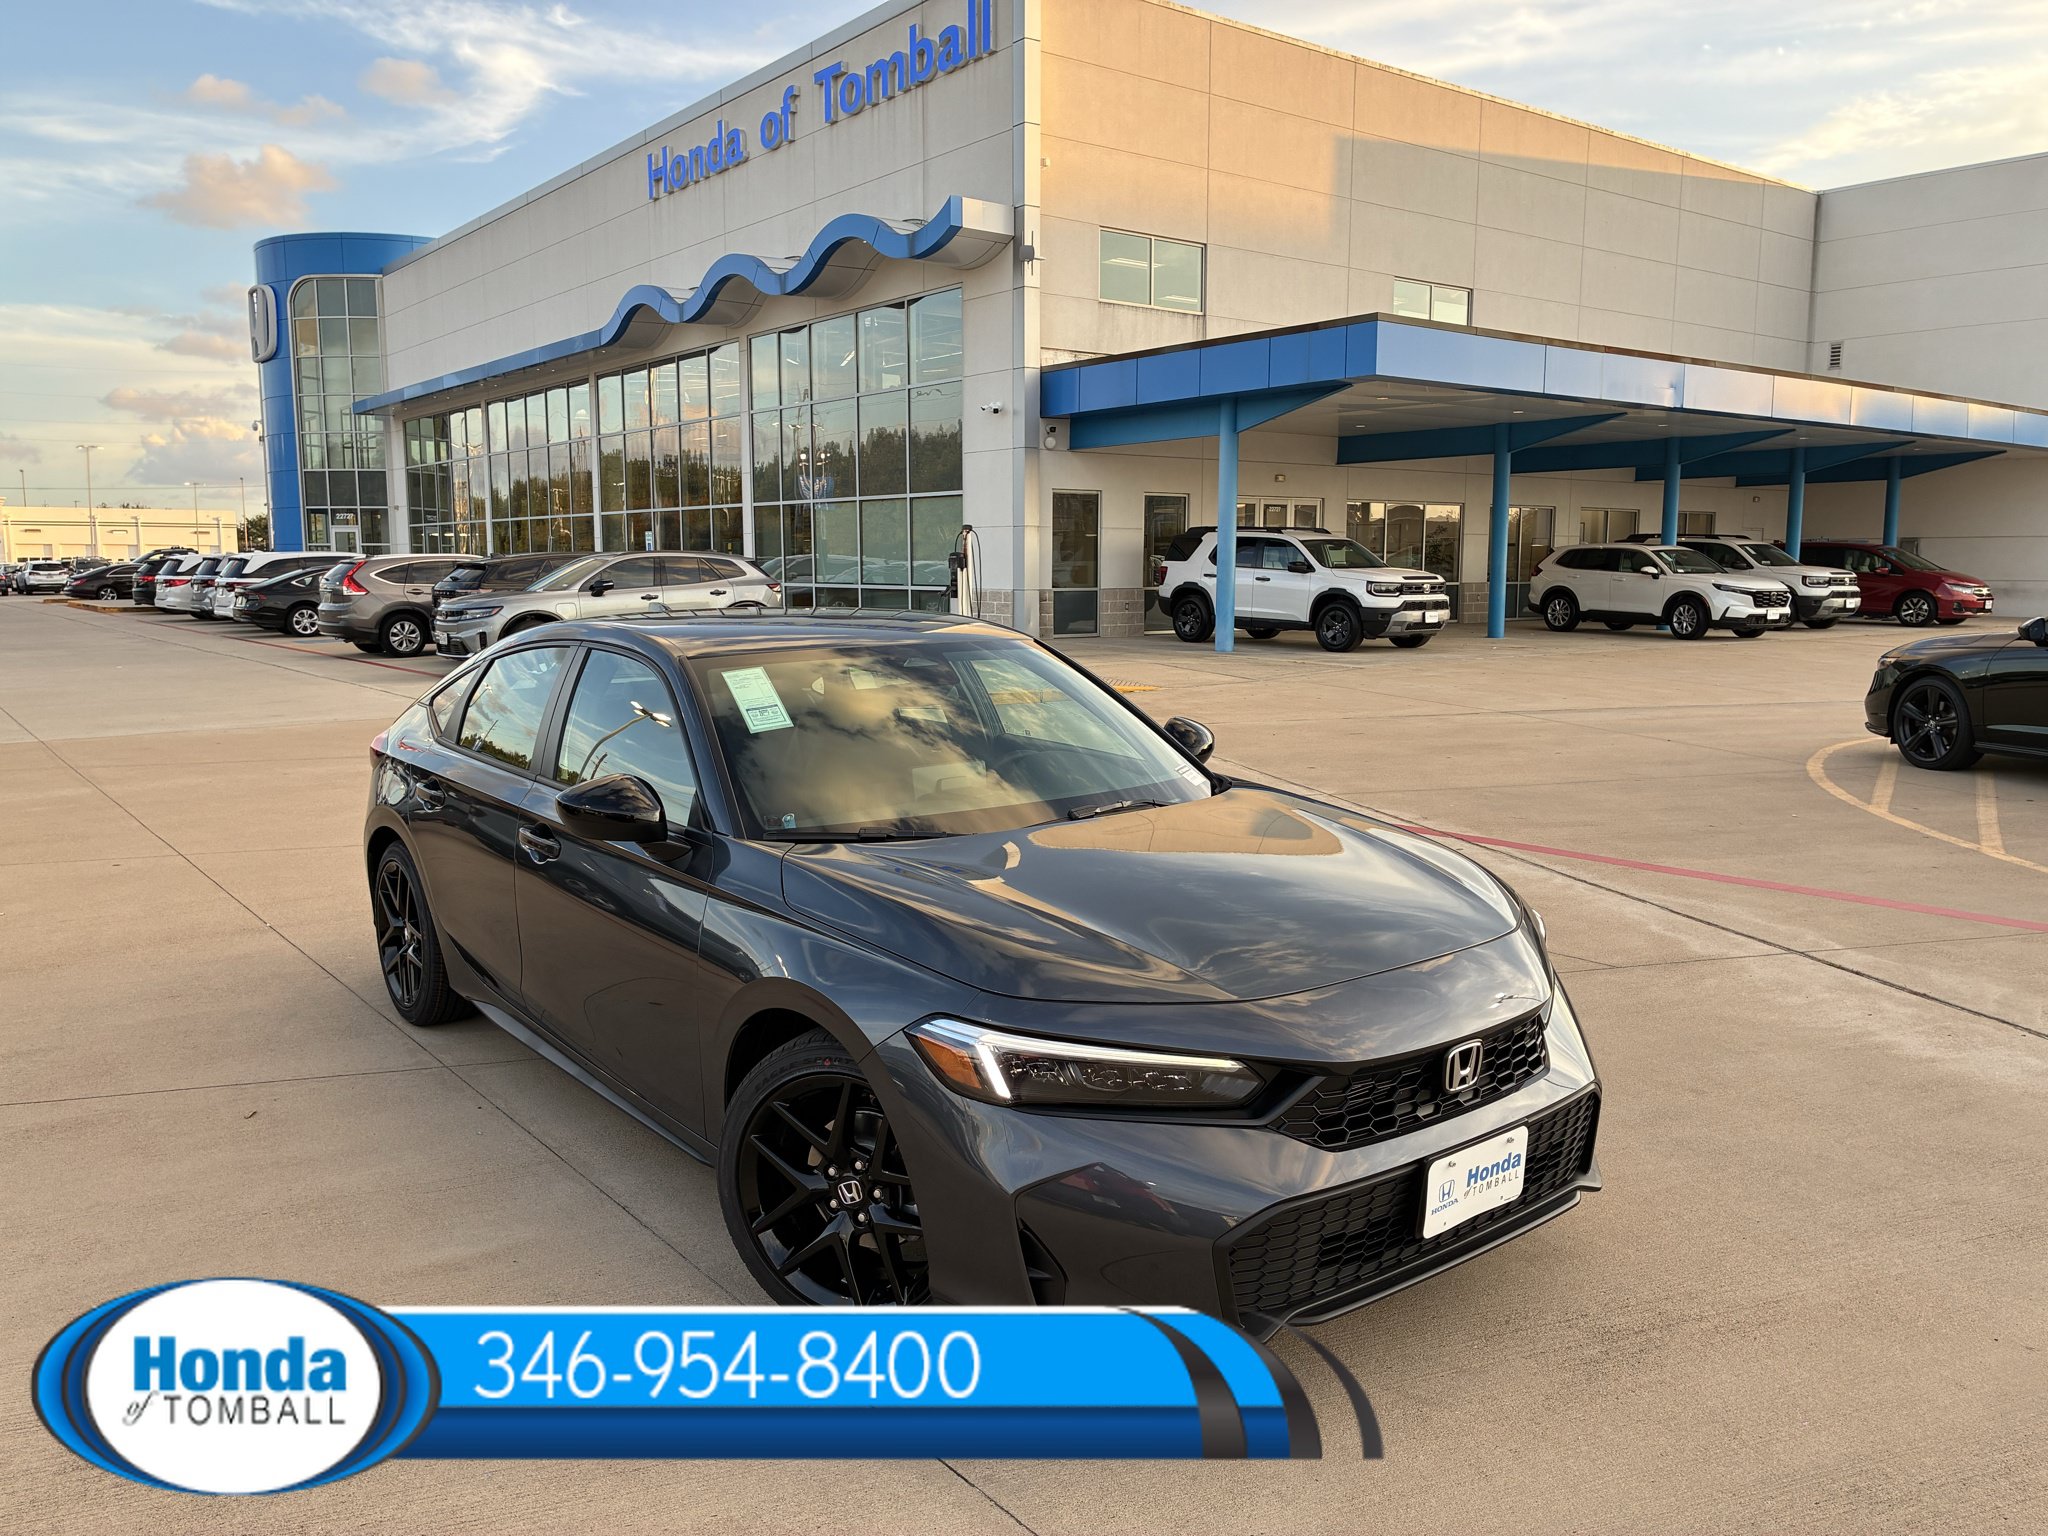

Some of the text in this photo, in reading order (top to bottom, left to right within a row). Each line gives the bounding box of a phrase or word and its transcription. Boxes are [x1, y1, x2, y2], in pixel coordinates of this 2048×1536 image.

[647, 0, 995, 200] Honda of Tomball
[1463, 1172, 1519, 1200] of TOMBALL
[1466, 1152, 1521, 1188] Honda
[1431, 1198, 1459, 1215] HONDA
